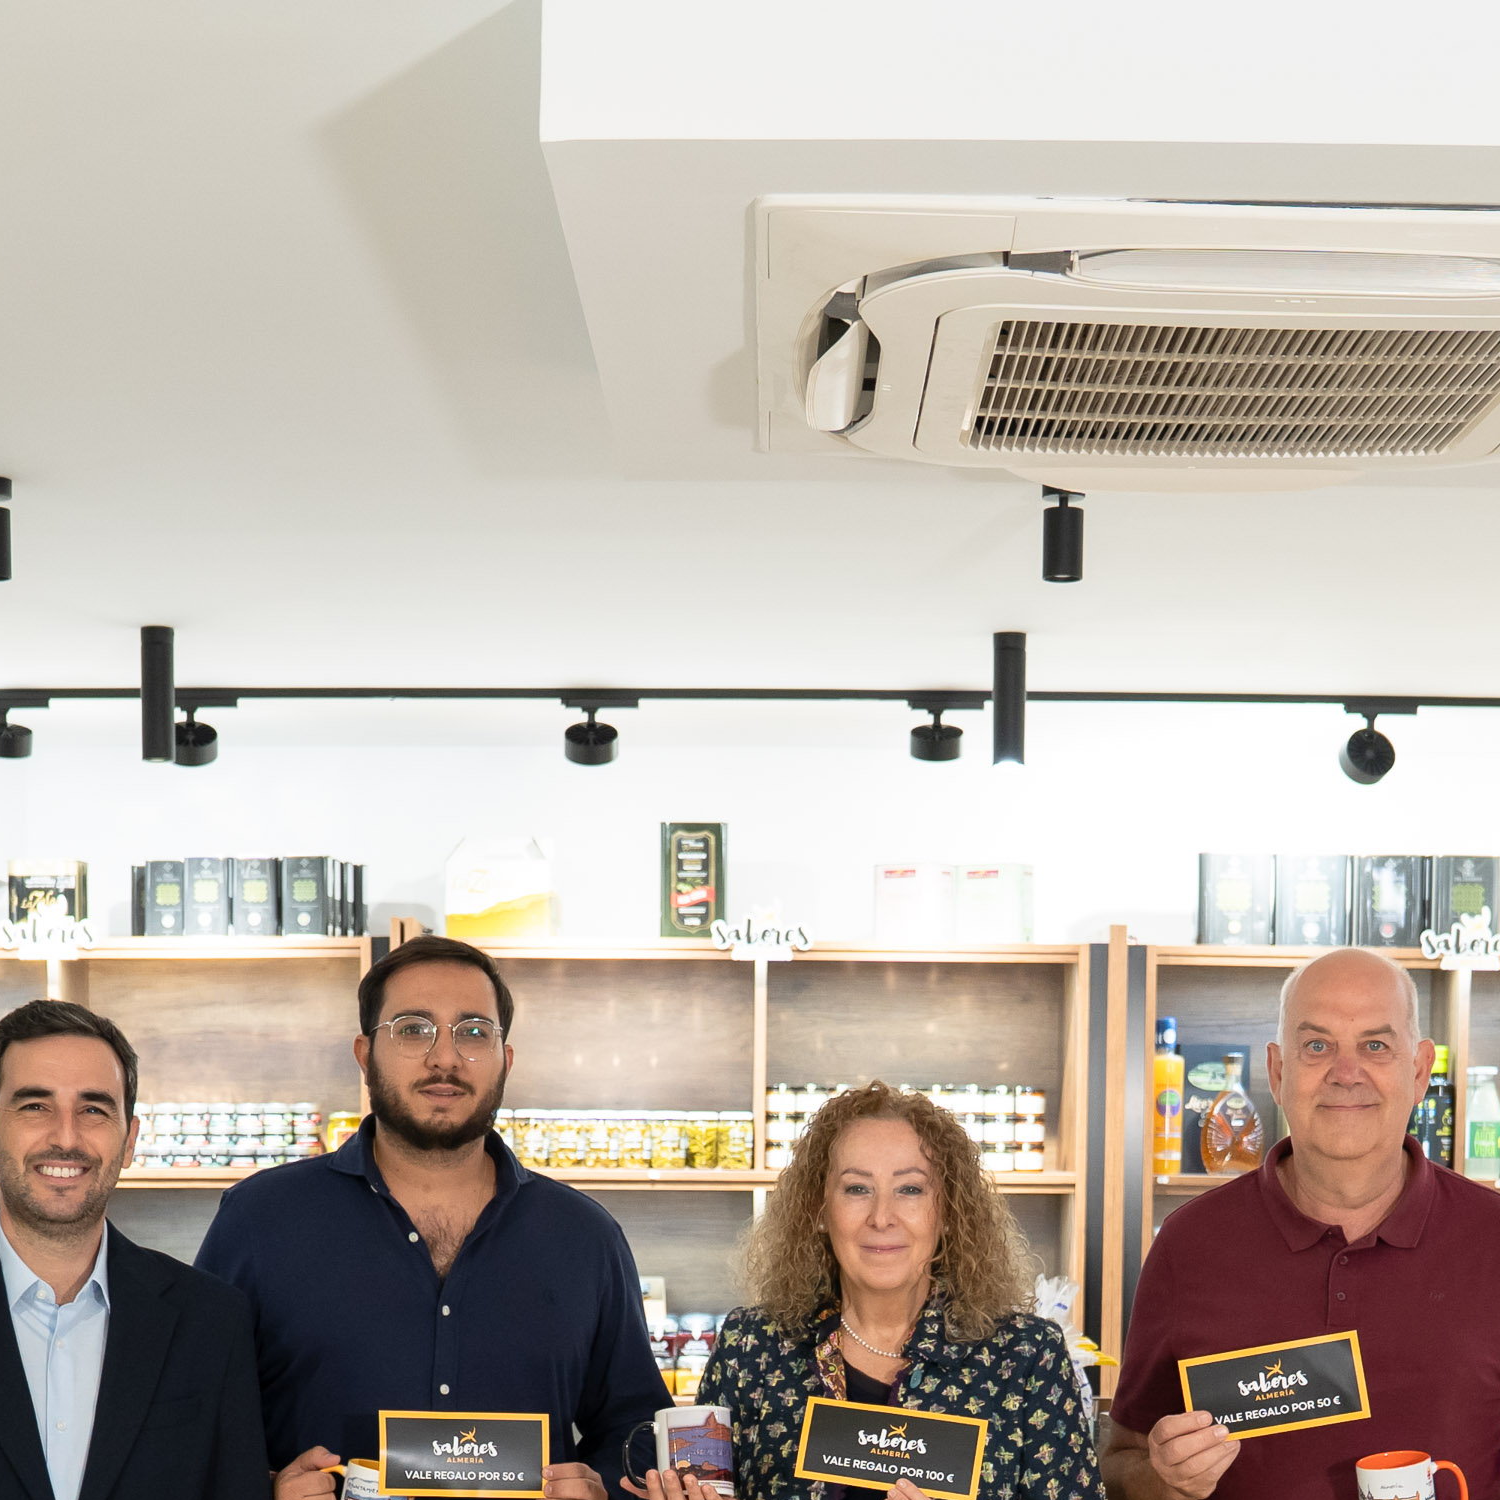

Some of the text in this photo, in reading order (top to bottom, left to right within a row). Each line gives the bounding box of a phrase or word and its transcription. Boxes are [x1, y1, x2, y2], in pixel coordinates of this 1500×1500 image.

[1254, 1388, 1295, 1401] ALMERÍA
[1214, 1395, 1341, 1425] VALE REGALO POR 50 €
[446, 1456, 484, 1464] ALMERÍA
[870, 1447, 911, 1460] ALMERÍA
[822, 1454, 955, 1483] VALE REGALO POR 100 €
[405, 1470, 525, 1481] VALE REGALO POR 50 €
